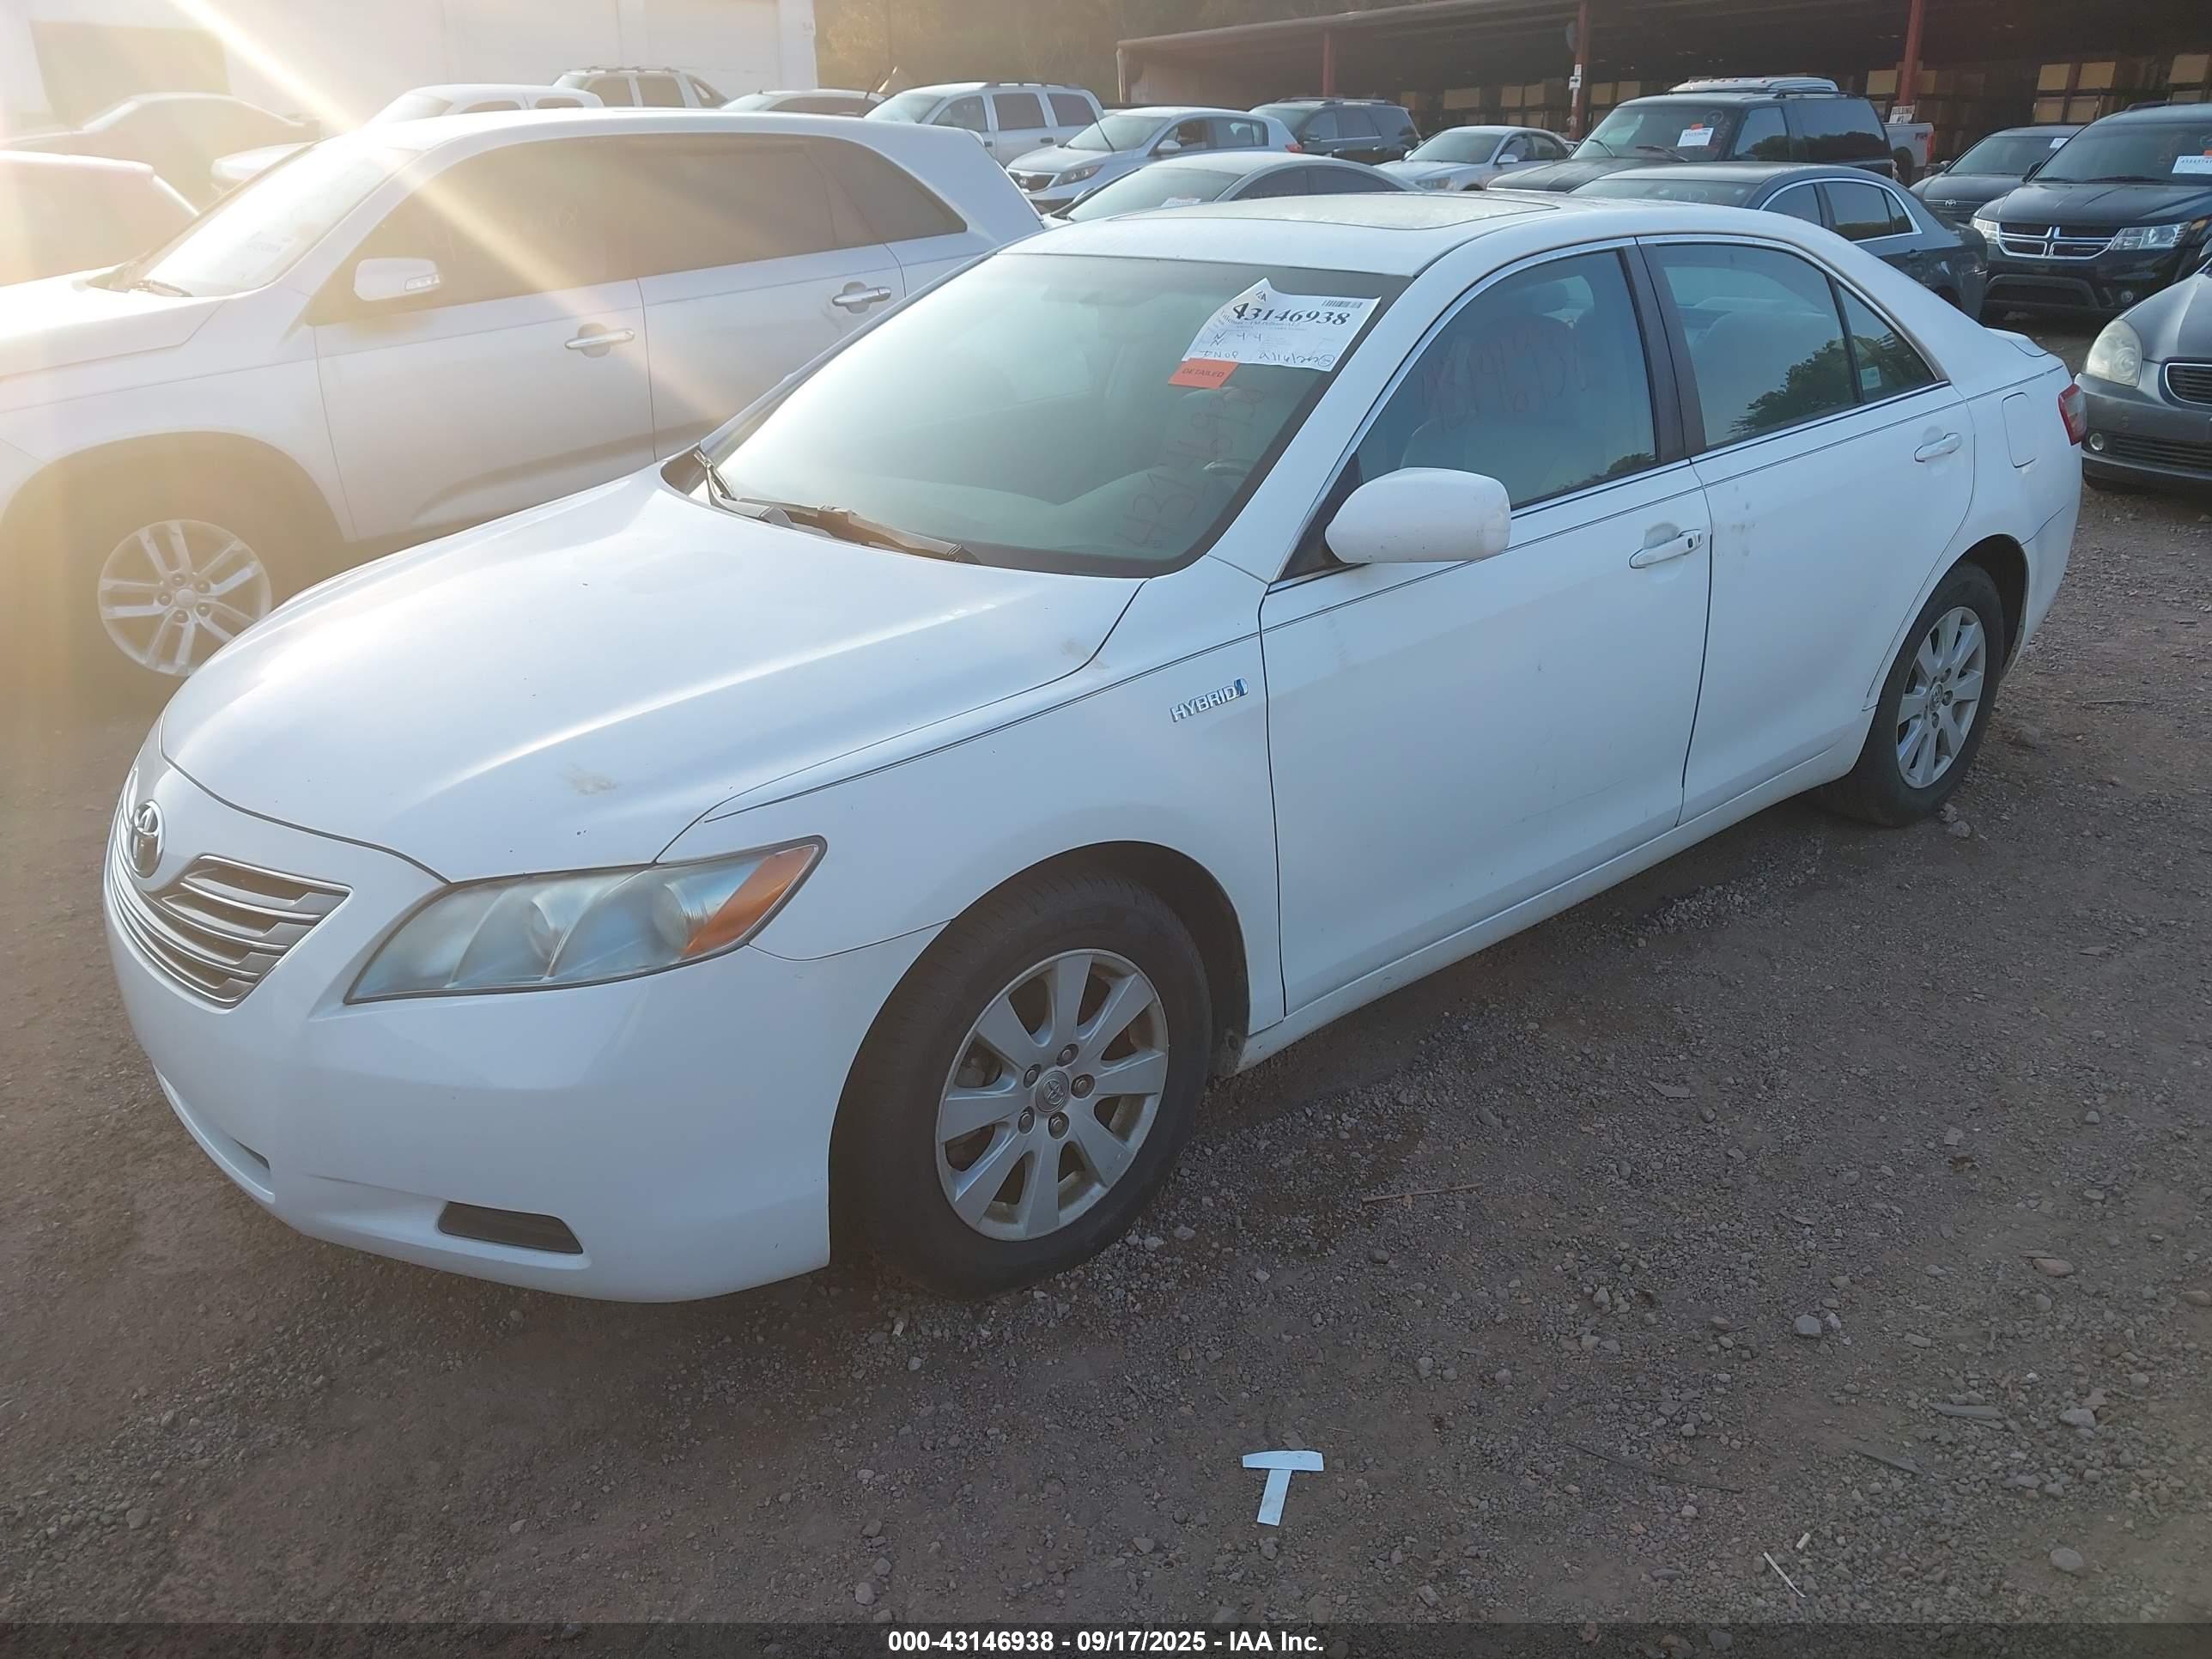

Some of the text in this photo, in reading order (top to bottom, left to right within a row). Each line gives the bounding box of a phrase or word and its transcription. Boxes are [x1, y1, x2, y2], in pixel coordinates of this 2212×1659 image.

[1232, 302, 1351, 325] 43146938
[1182, 368, 1224, 378] DETAILED
[1170, 686, 1237, 722] HYBRID
